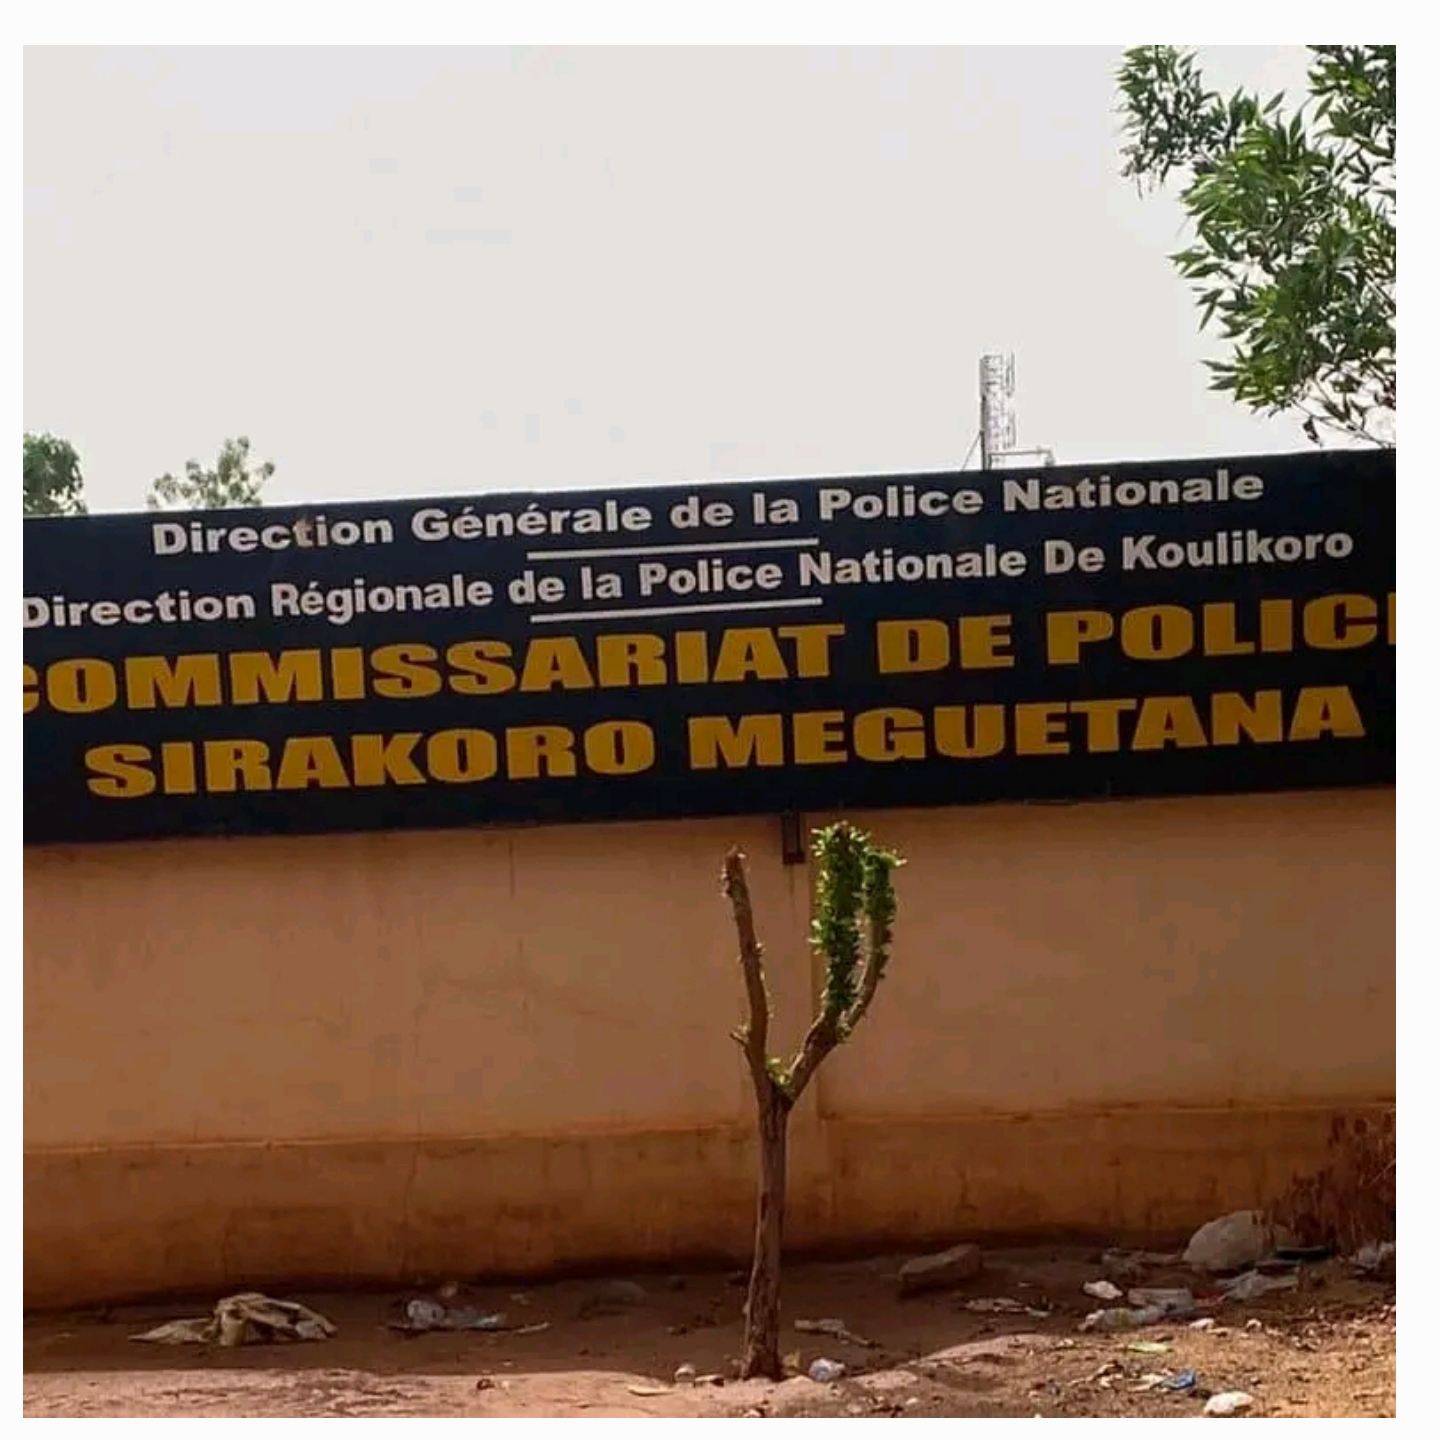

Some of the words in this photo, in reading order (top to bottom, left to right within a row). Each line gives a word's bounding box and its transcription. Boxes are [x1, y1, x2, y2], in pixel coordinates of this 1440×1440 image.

[151, 515, 394, 555] Direction
[410, 498, 653, 542] Générale
[669, 490, 735, 530] de
[753, 490, 800, 524] la
[818, 482, 985, 522] Police
[1002, 467, 1266, 513] Nationale
[23, 590, 256, 629] Direction
[271, 572, 494, 626] Régionale
[508, 569, 569, 604] de
[581, 564, 625, 600] la
[639, 552, 783, 597] Police
[798, 541, 1028, 587] Nationale
[1043, 538, 1106, 576] De
[1121, 527, 1355, 571] Koulikoro
[23, 620, 847, 715] OMMISSARIAT
[875, 612, 1016, 675] DE
[1045, 593, 1396, 666] POLIC
[83, 719, 655, 799] SIRAKORO
[688, 685, 1367, 770] MEGUETANA
